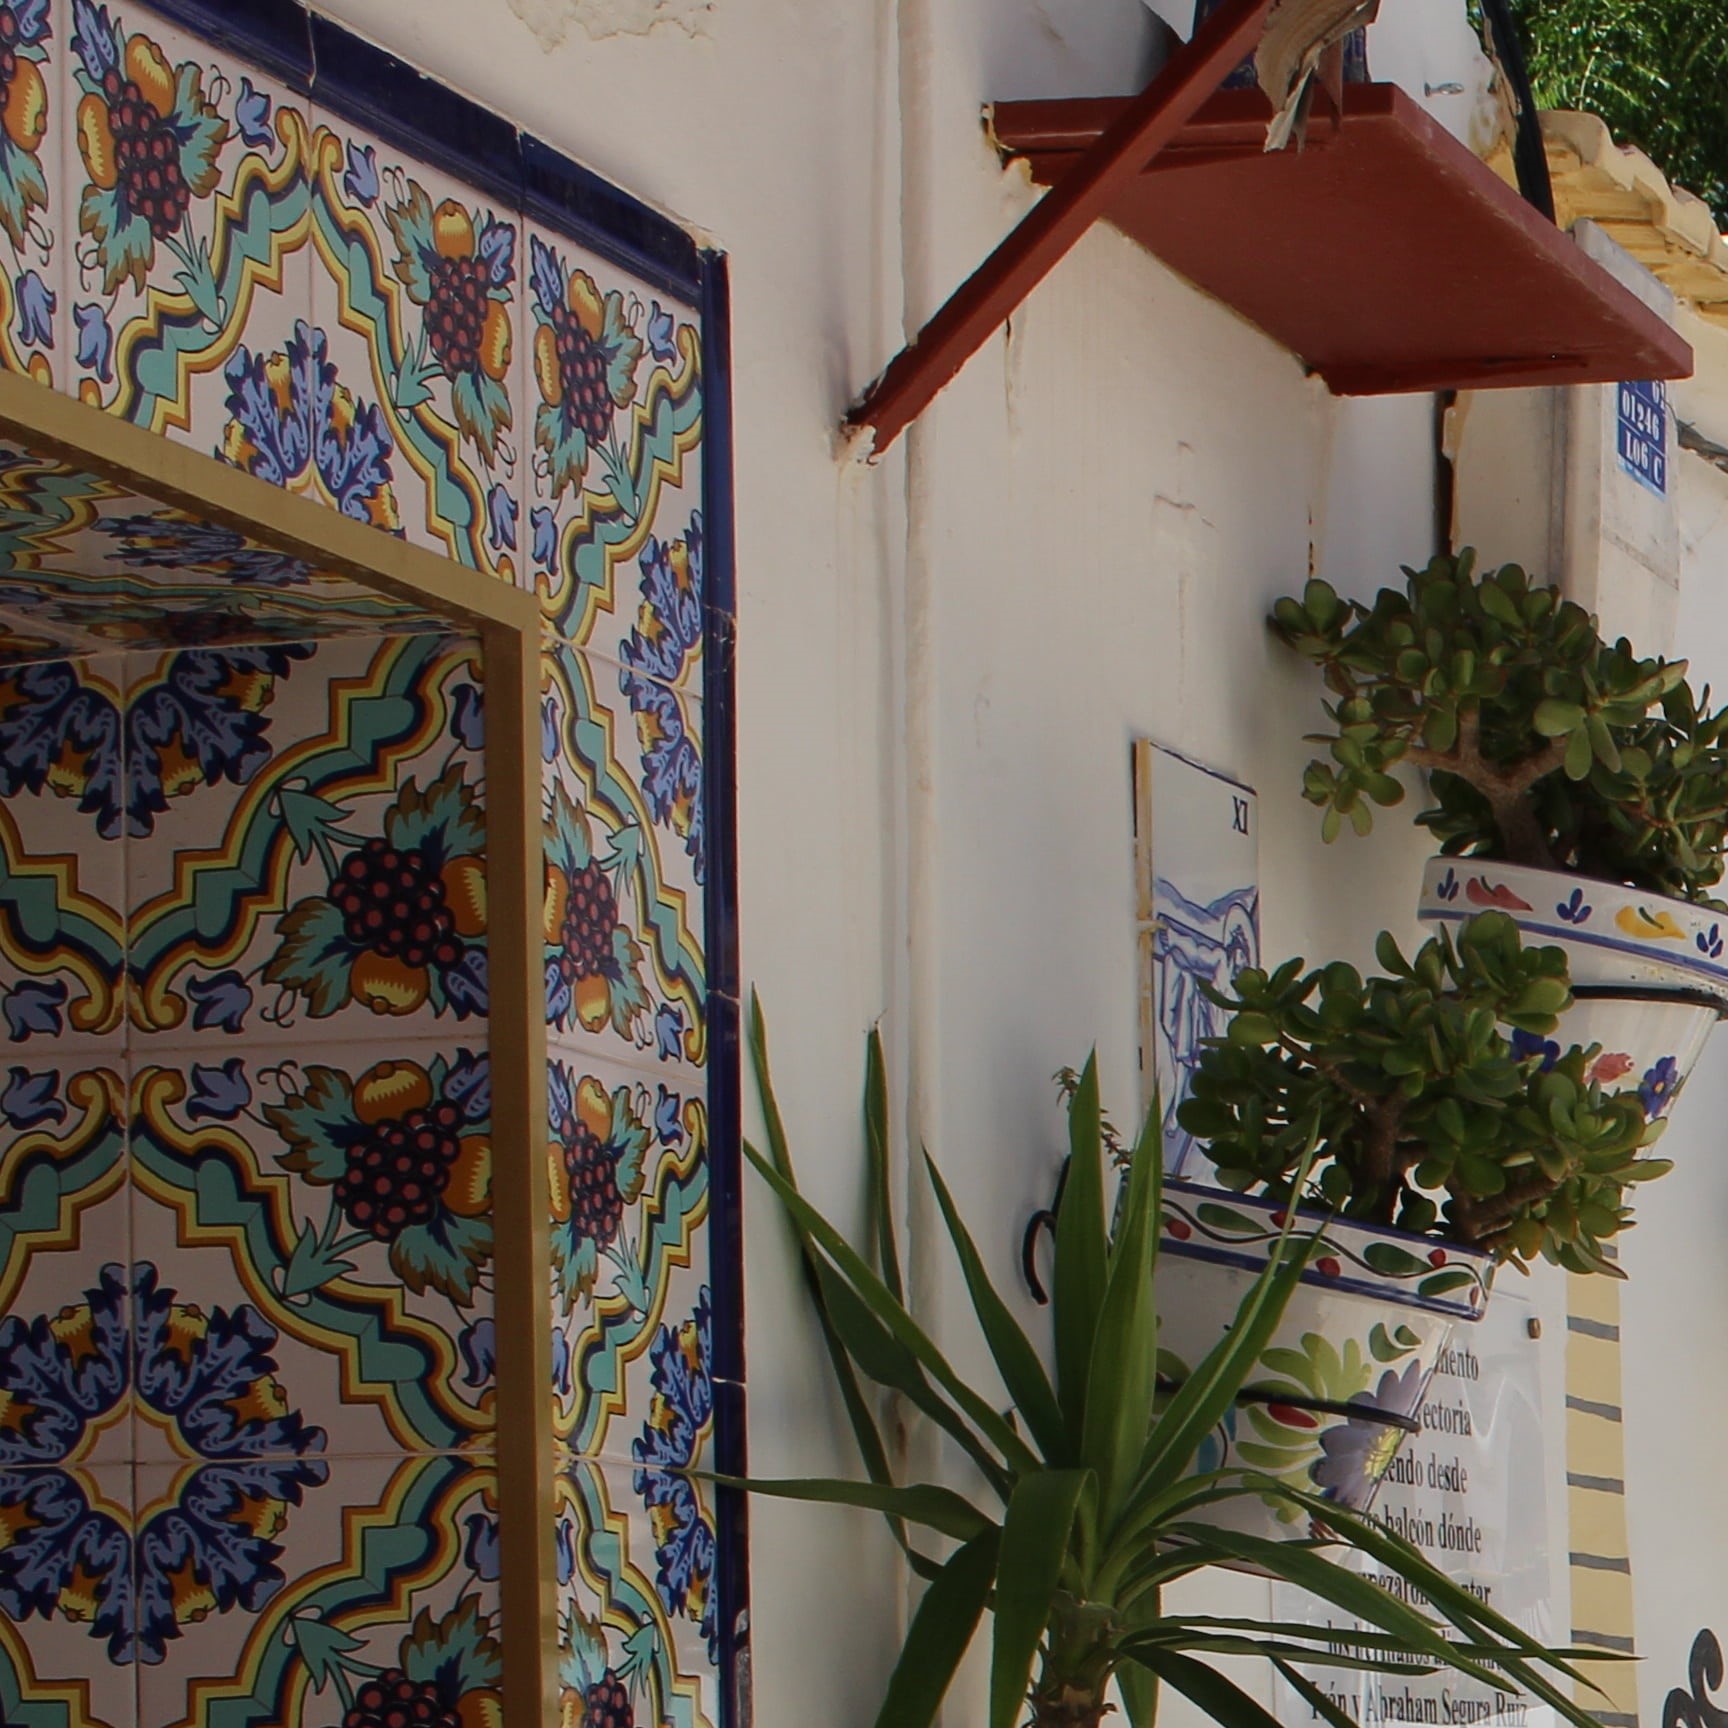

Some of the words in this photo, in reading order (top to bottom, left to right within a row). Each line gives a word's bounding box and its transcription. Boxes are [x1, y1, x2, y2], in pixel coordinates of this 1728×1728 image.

[1621, 388, 1661, 442] 01246
[1653, 455, 1663, 485] C
[1427, 1451, 1468, 1494] desde
[1384, 1504, 1434, 1548] balcón
[1437, 1512, 1482, 1554] dónde
[1365, 1684, 1438, 1726] Abraham
[1494, 1691, 1530, 1728] Ruiz
